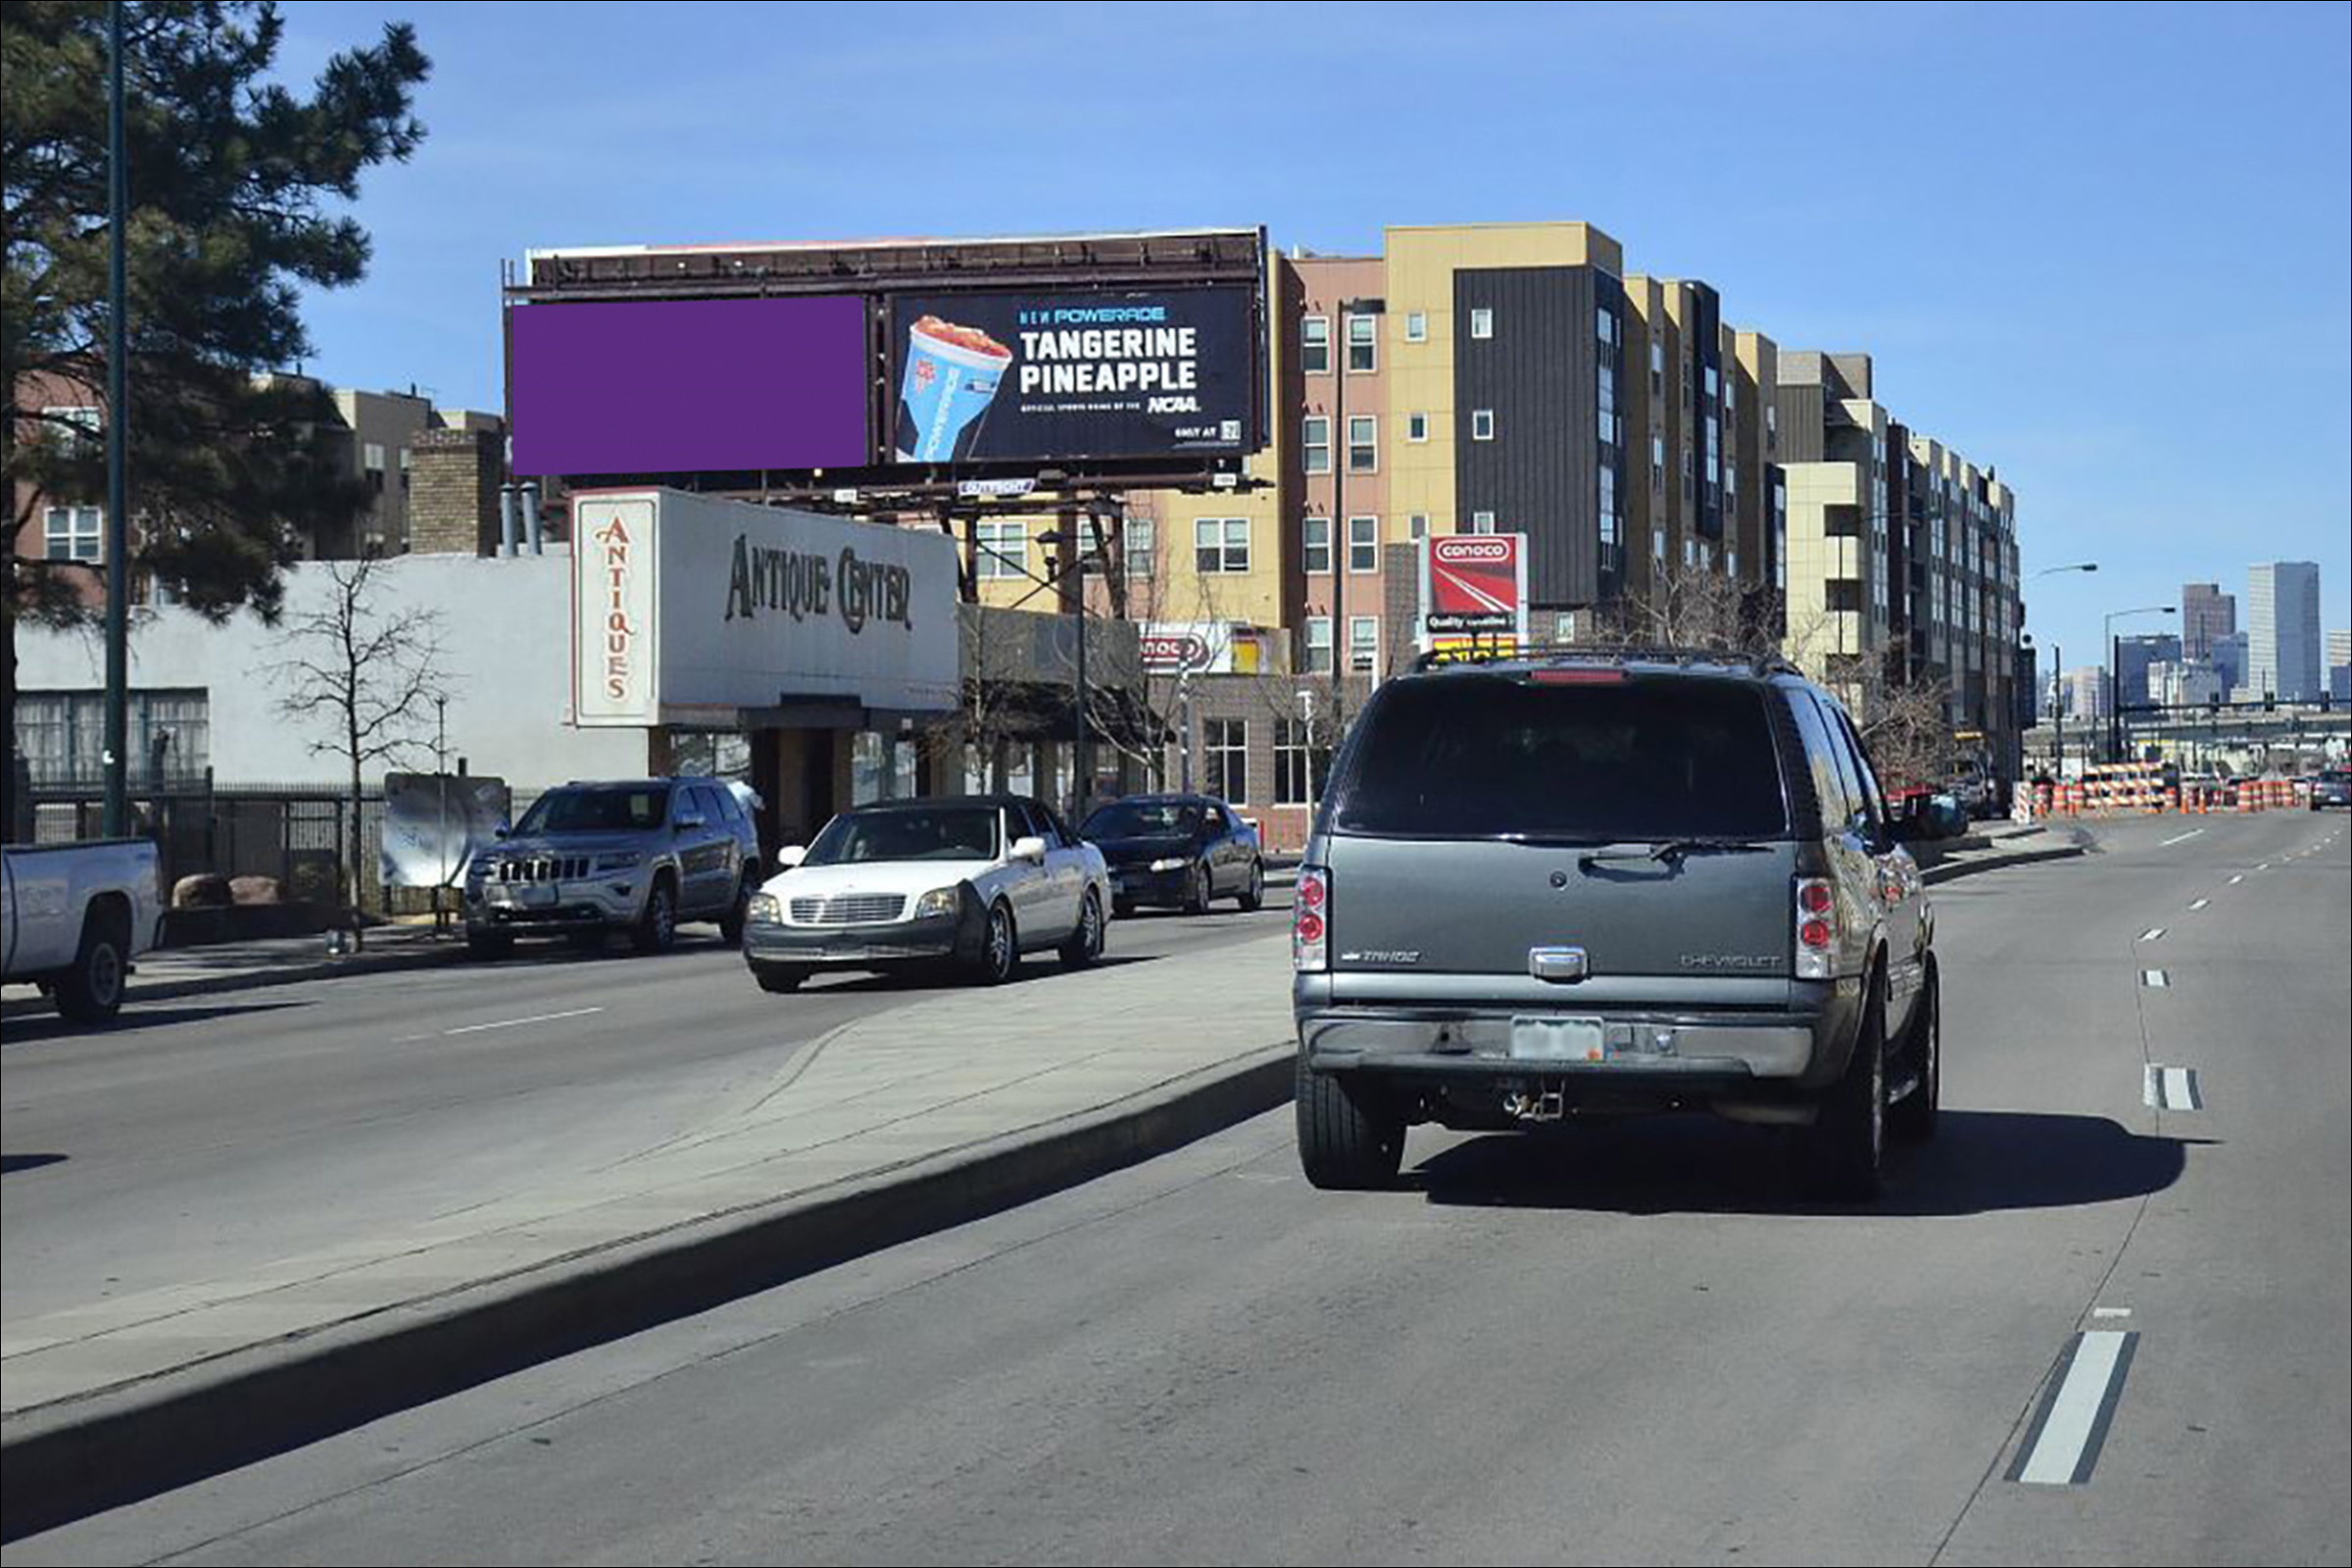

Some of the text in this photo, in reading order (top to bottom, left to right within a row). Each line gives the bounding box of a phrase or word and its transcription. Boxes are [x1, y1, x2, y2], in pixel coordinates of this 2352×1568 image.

[1054, 307, 1166, 323] POWERADE
[1019, 327, 1197, 360] TANGERINE
[1019, 361, 1197, 393] PINEAPPLE
[724, 533, 913, 635] ANTIQUE CENTER
[596, 516, 637, 699] ANTIQUES
[1363, 951, 1420, 962] TAHOE
[1680, 955, 1782, 967] CHEVROLET
